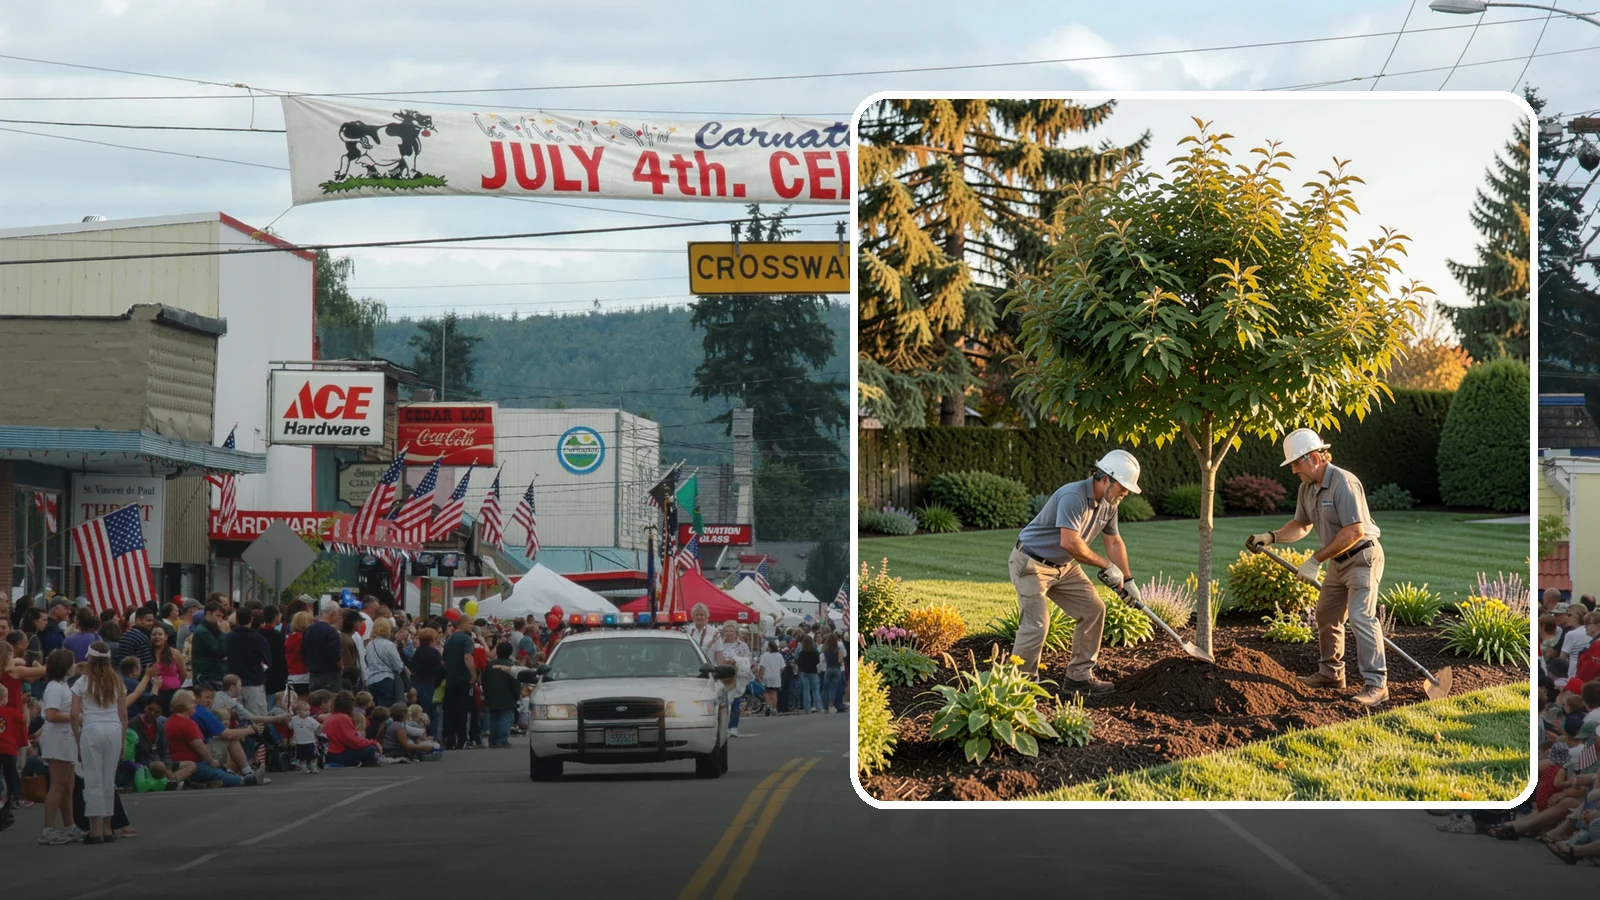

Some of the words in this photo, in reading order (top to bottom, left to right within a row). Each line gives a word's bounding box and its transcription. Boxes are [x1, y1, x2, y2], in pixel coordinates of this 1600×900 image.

[695, 121, 850, 149] Carnat
[481, 141, 605, 193] JULY
[632, 150, 746, 197] 4th.
[697, 254, 850, 280] CROSSWA
[283, 380, 374, 419] ACE
[405, 409, 452, 422] CEDAR
[283, 421, 370, 436] Hardware
[416, 428, 477, 447] Coca-Cola
[353, 467, 385, 480] Simpl
[95, 485, 124, 494] Vincent
[126, 486, 135, 494] de
[137, 486, 155, 495] Paul
[688, 526, 741, 535] CRNATION
[699, 535, 730, 543] GLASS
